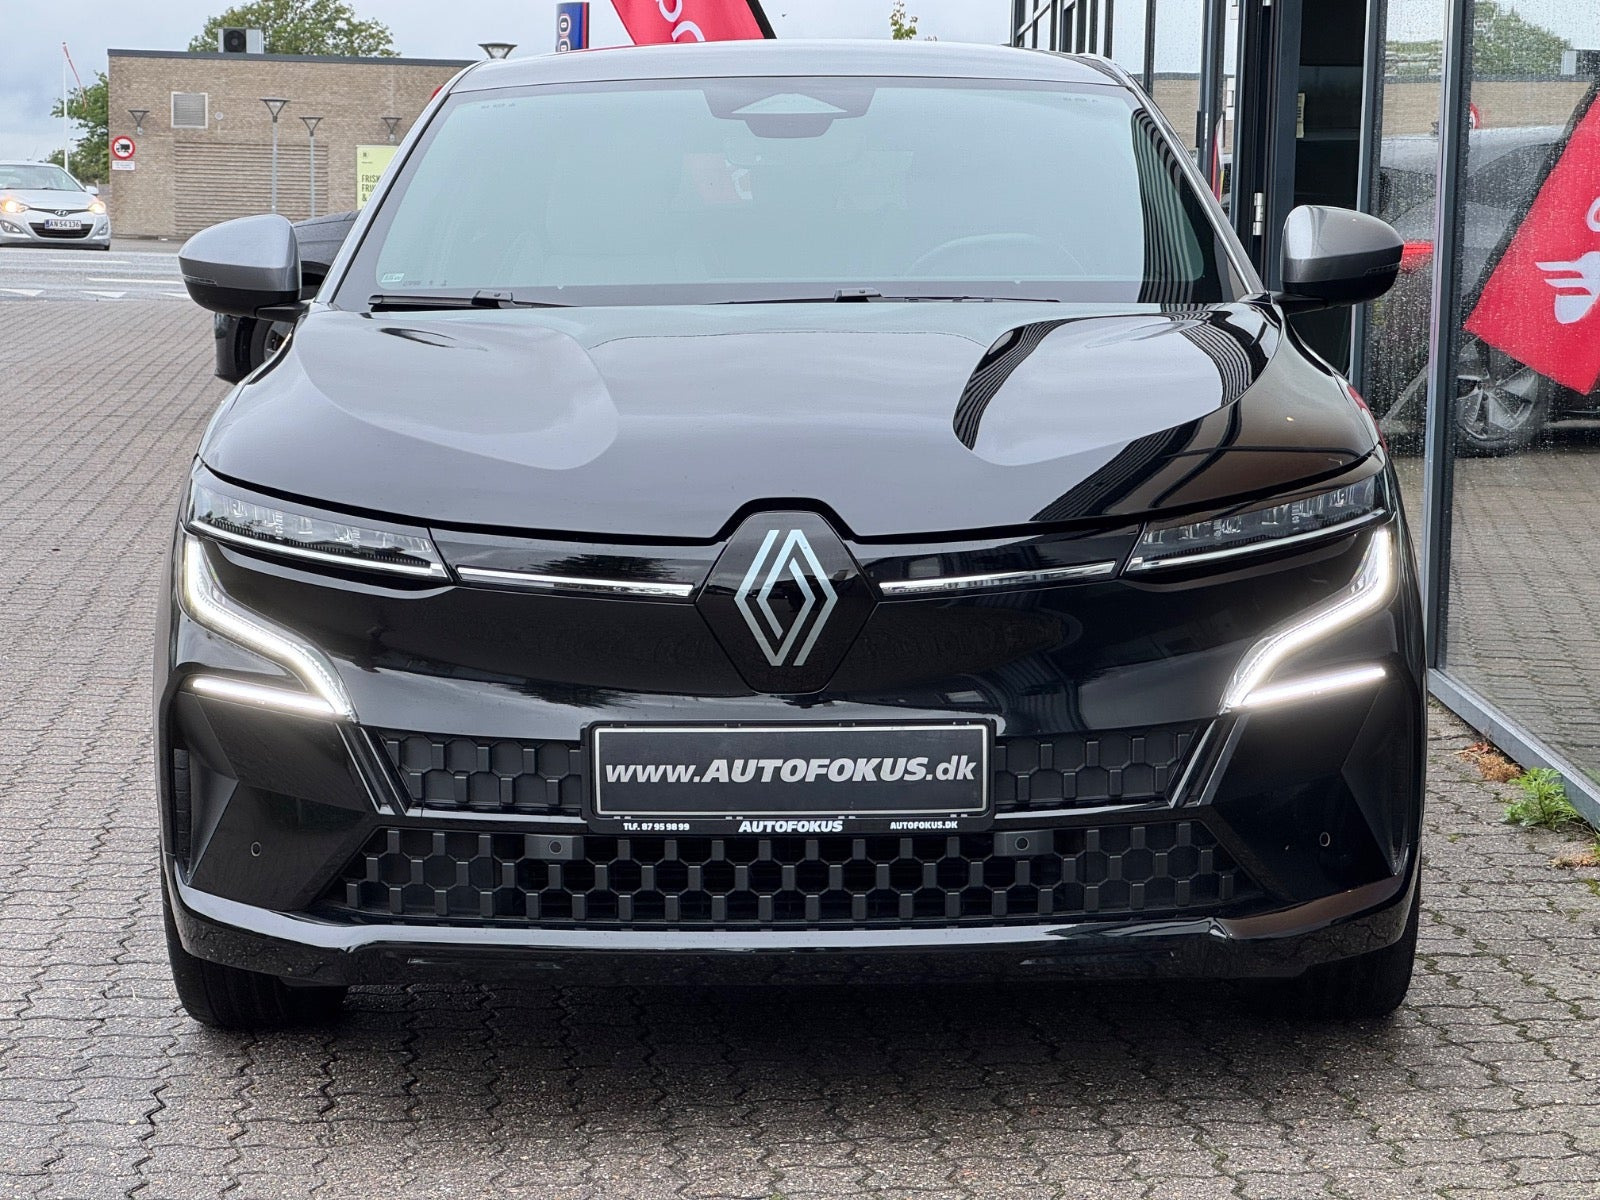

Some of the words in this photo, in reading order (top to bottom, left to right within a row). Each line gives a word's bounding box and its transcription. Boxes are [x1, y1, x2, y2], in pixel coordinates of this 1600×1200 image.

[605, 755, 977, 783] www.AUTOFOKUS.dk
[623, 823, 640, 831] TLF.
[641, 823, 653, 831] 87
[654, 823, 665, 831] 95
[666, 823, 677, 831] 98
[678, 823, 690, 831] 99
[738, 820, 843, 833] AUTOFOKUS
[890, 820, 958, 830] AUTOFOKUS.DK
